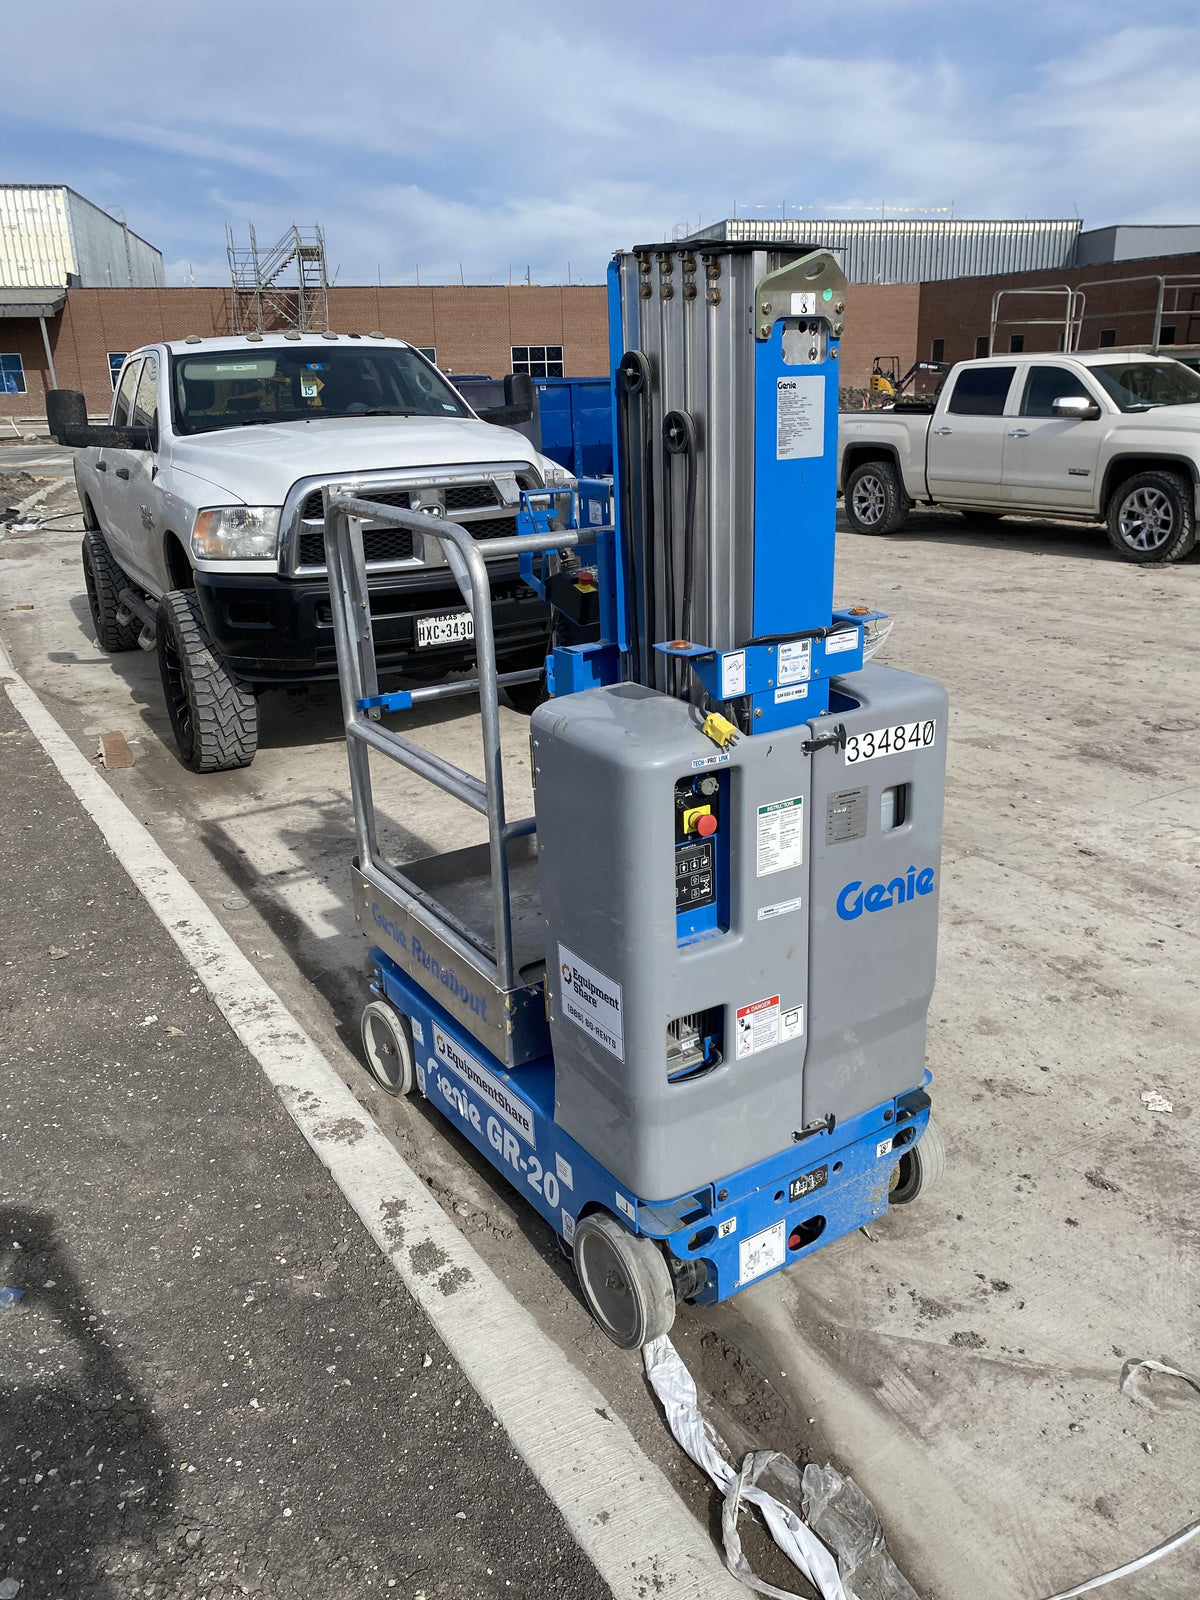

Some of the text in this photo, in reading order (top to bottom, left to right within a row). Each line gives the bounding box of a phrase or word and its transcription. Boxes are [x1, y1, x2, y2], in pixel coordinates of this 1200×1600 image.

[777, 381, 797, 390] Genie
[433, 614, 458, 622] TEXAS
[846, 720, 935, 762] 334840
[836, 865, 935, 921] Genie
[371, 902, 488, 1022] Genie Runabout
[572, 967, 620, 1011] Equipment
[573, 981, 598, 1008] Share
[751, 1000, 771, 1012] DANGER
[567, 1003, 616, 1049] (888) 80-RENTS
[446, 1043, 530, 1131] EquipmentShare
[487, 1115, 560, 1208] GR-20
